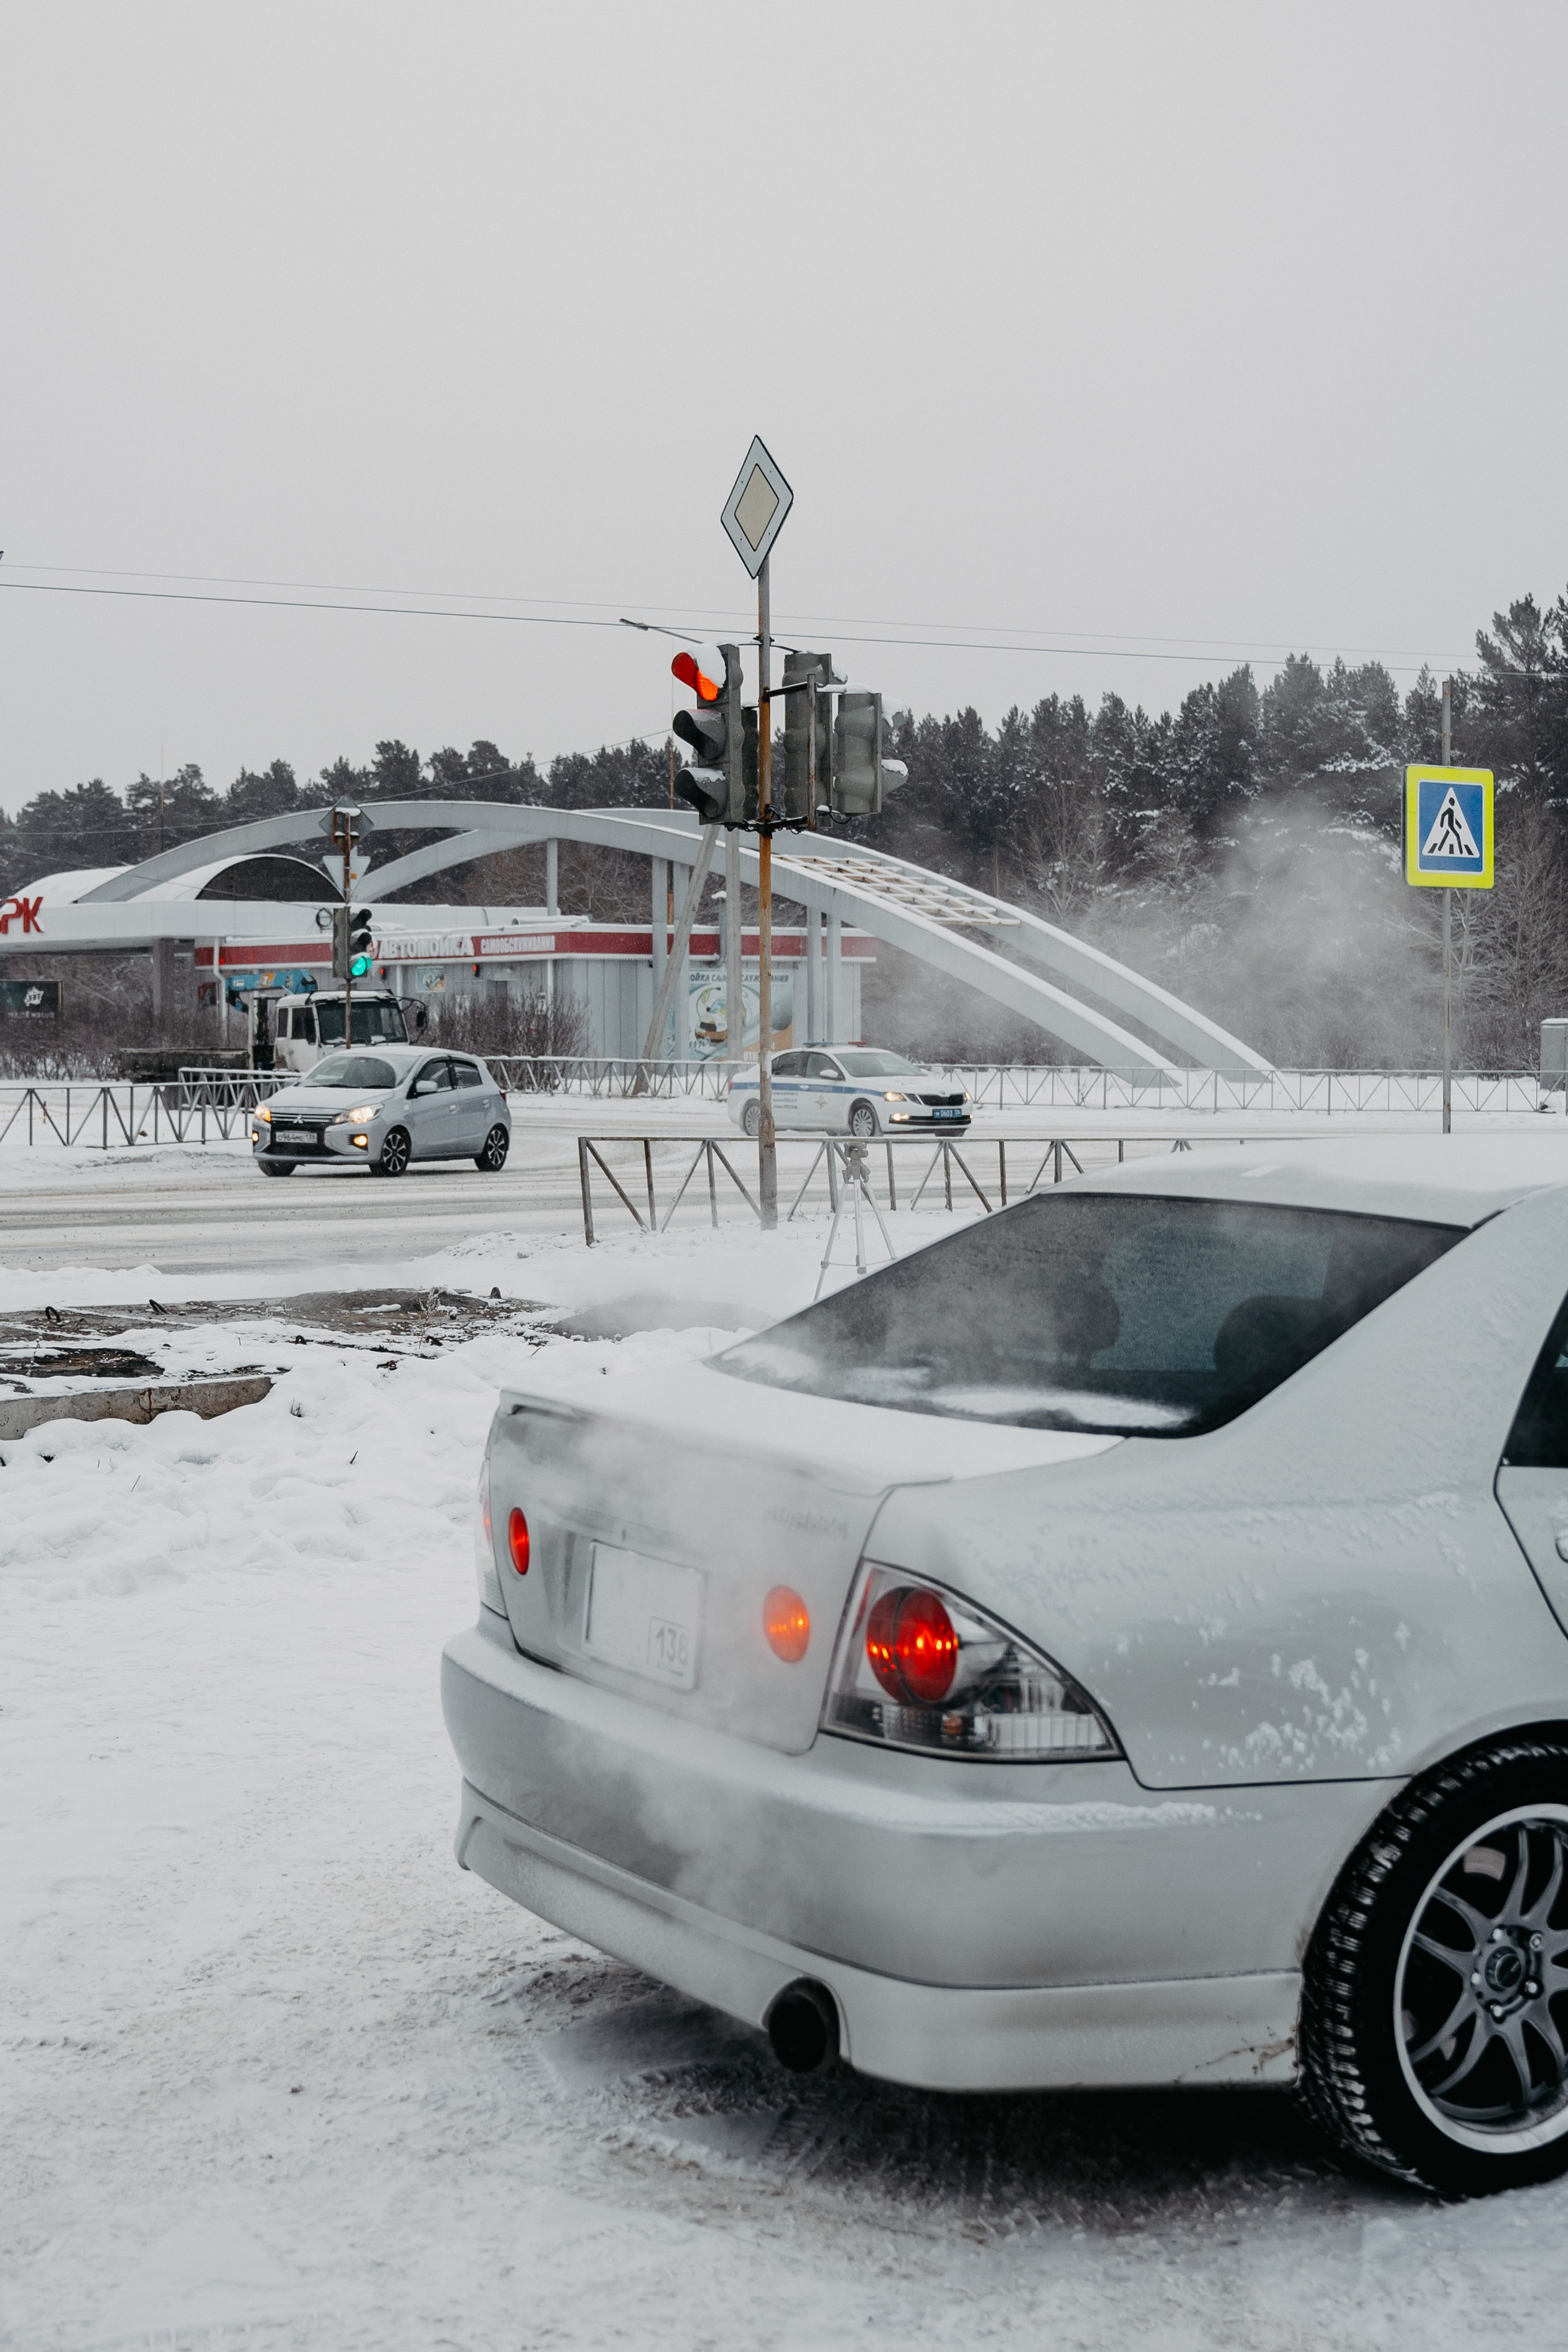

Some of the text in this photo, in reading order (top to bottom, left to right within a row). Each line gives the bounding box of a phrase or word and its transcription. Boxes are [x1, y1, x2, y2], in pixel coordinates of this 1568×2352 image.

[0, 897, 44, 935] РК
[689, 973, 709, 982] ОЙКА
[656, 1626, 689, 1665] 138
